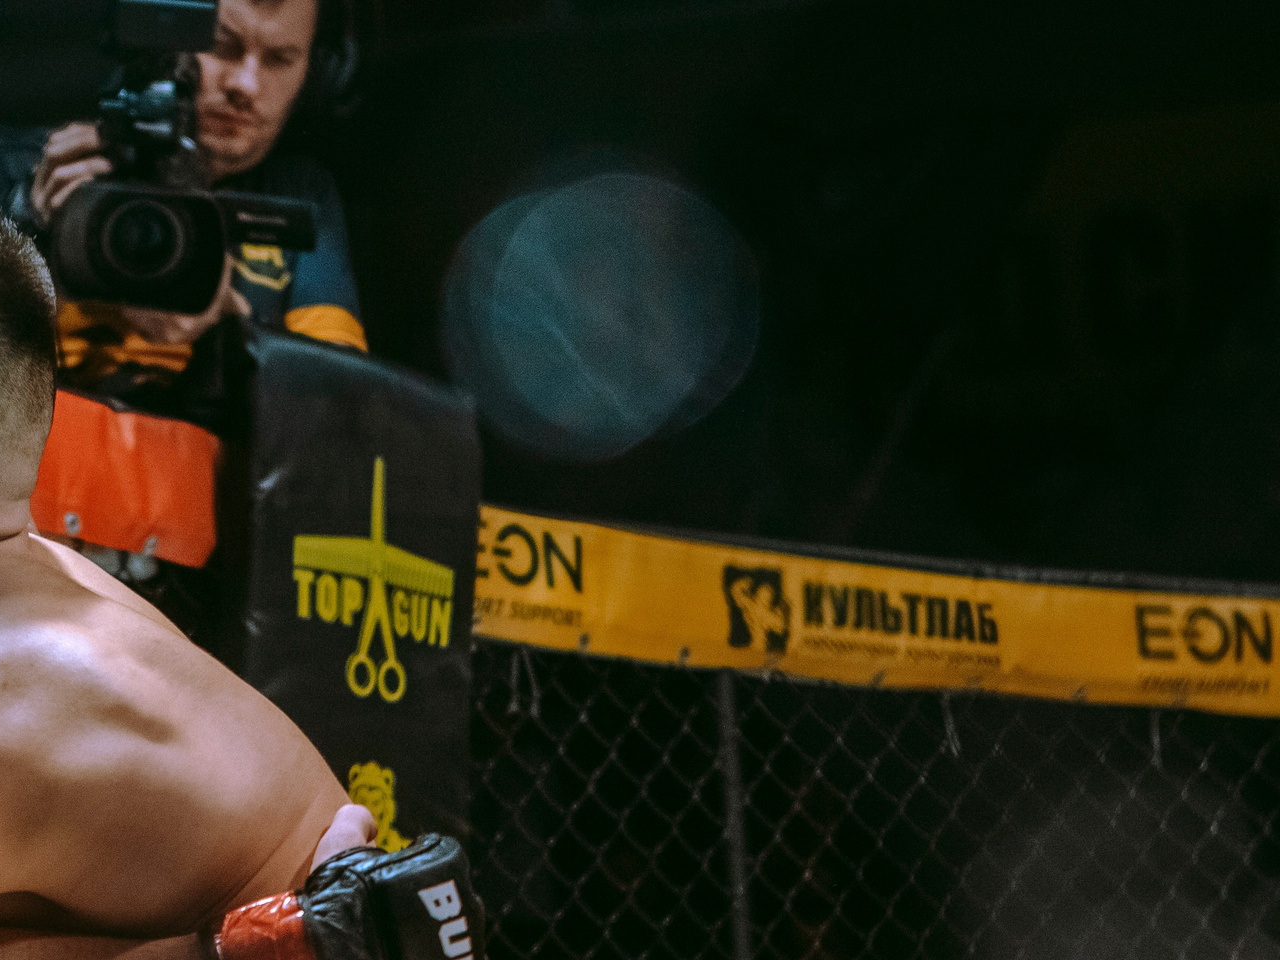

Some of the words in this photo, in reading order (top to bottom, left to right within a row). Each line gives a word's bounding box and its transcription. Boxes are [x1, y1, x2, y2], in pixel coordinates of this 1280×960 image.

[293, 569, 363, 626] TOP
[392, 589, 453, 649] GUN
[1136, 604, 1273, 664] EON
